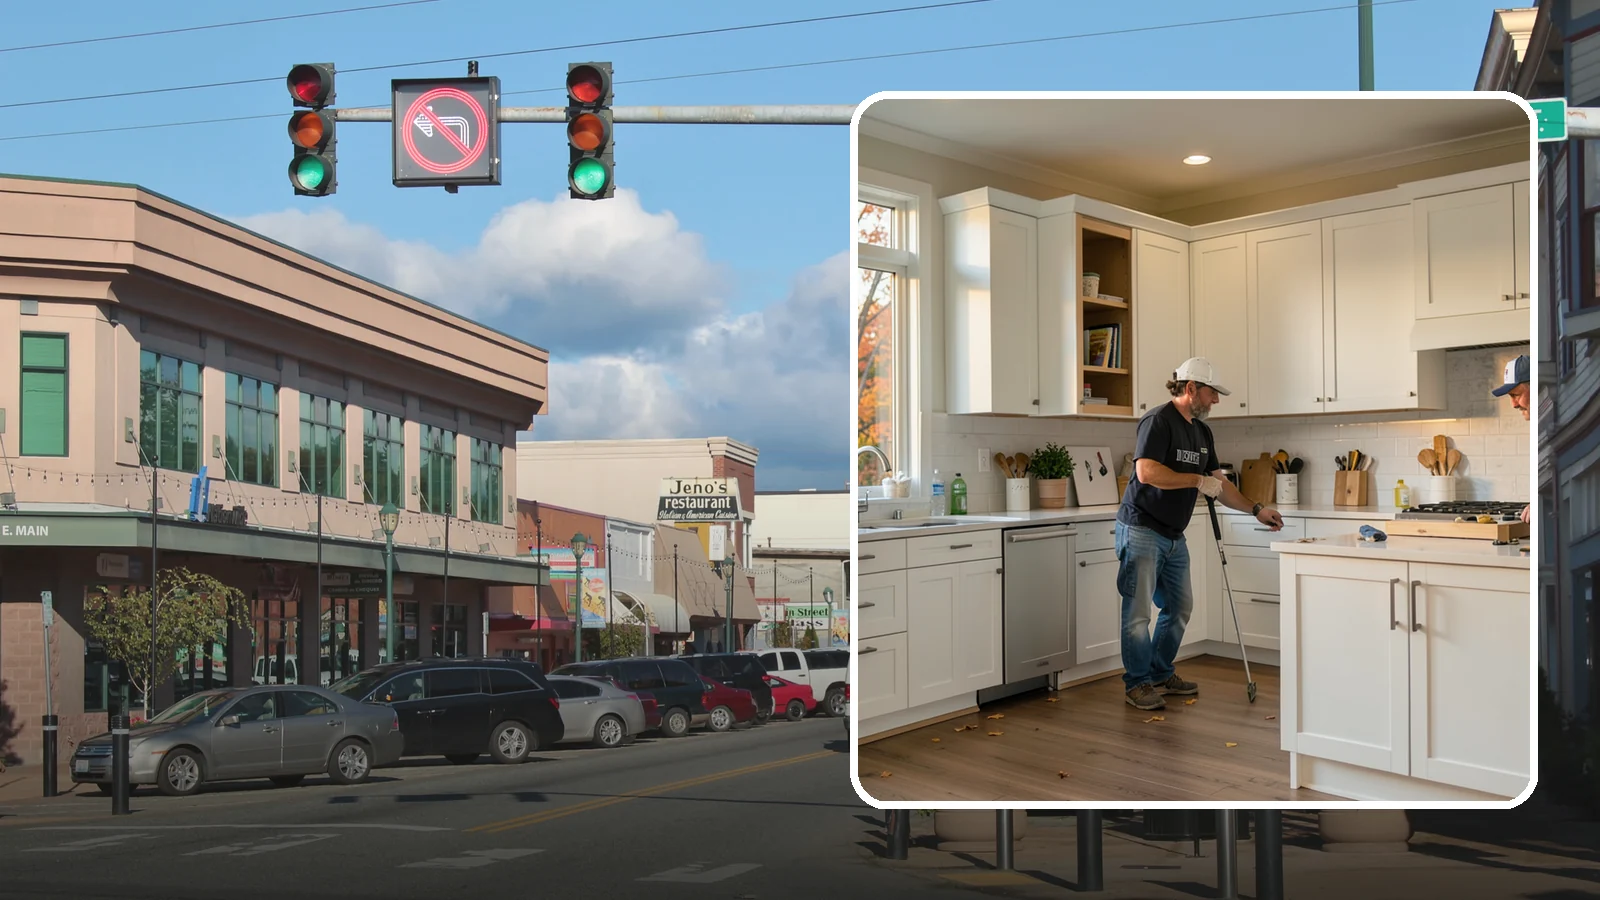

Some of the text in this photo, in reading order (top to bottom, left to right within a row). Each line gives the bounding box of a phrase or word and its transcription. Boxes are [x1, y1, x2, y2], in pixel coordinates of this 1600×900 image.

[670, 480, 727, 494] Jeno's
[665, 496, 731, 509] restaurant
[659, 509, 681, 519] Italian
[686, 509, 714, 519] American
[715, 509, 737, 519] Cuisine
[2, 525, 49, 536] E. MAIN
[797, 608, 828, 617] Street
